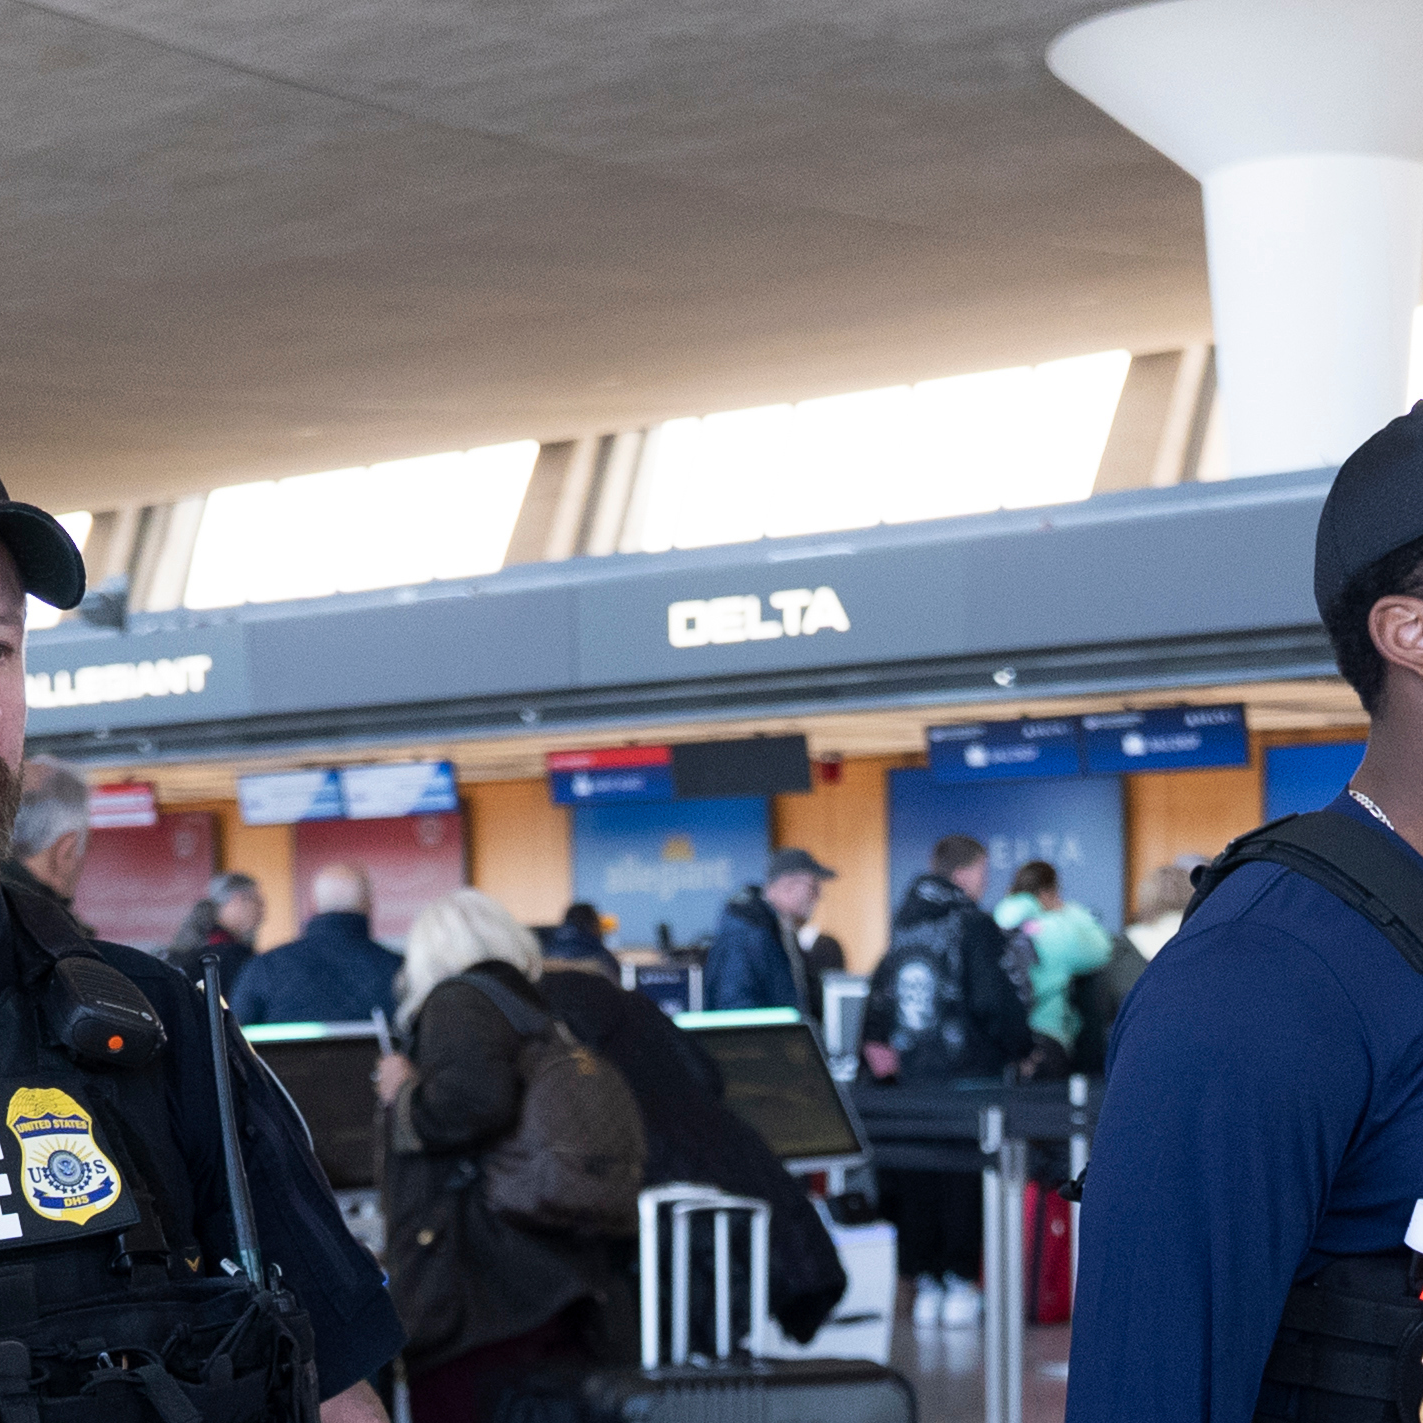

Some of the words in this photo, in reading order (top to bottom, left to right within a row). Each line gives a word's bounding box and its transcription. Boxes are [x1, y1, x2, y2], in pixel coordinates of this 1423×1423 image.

[668, 586, 850, 648] DELTA
[16, 1119, 52, 1133] UNITED
[53, 1119, 88, 1129] STATES
[27, 1167, 42, 1183] U
[93, 1159, 107, 1174] S
[63, 1195, 89, 1207] DHS
